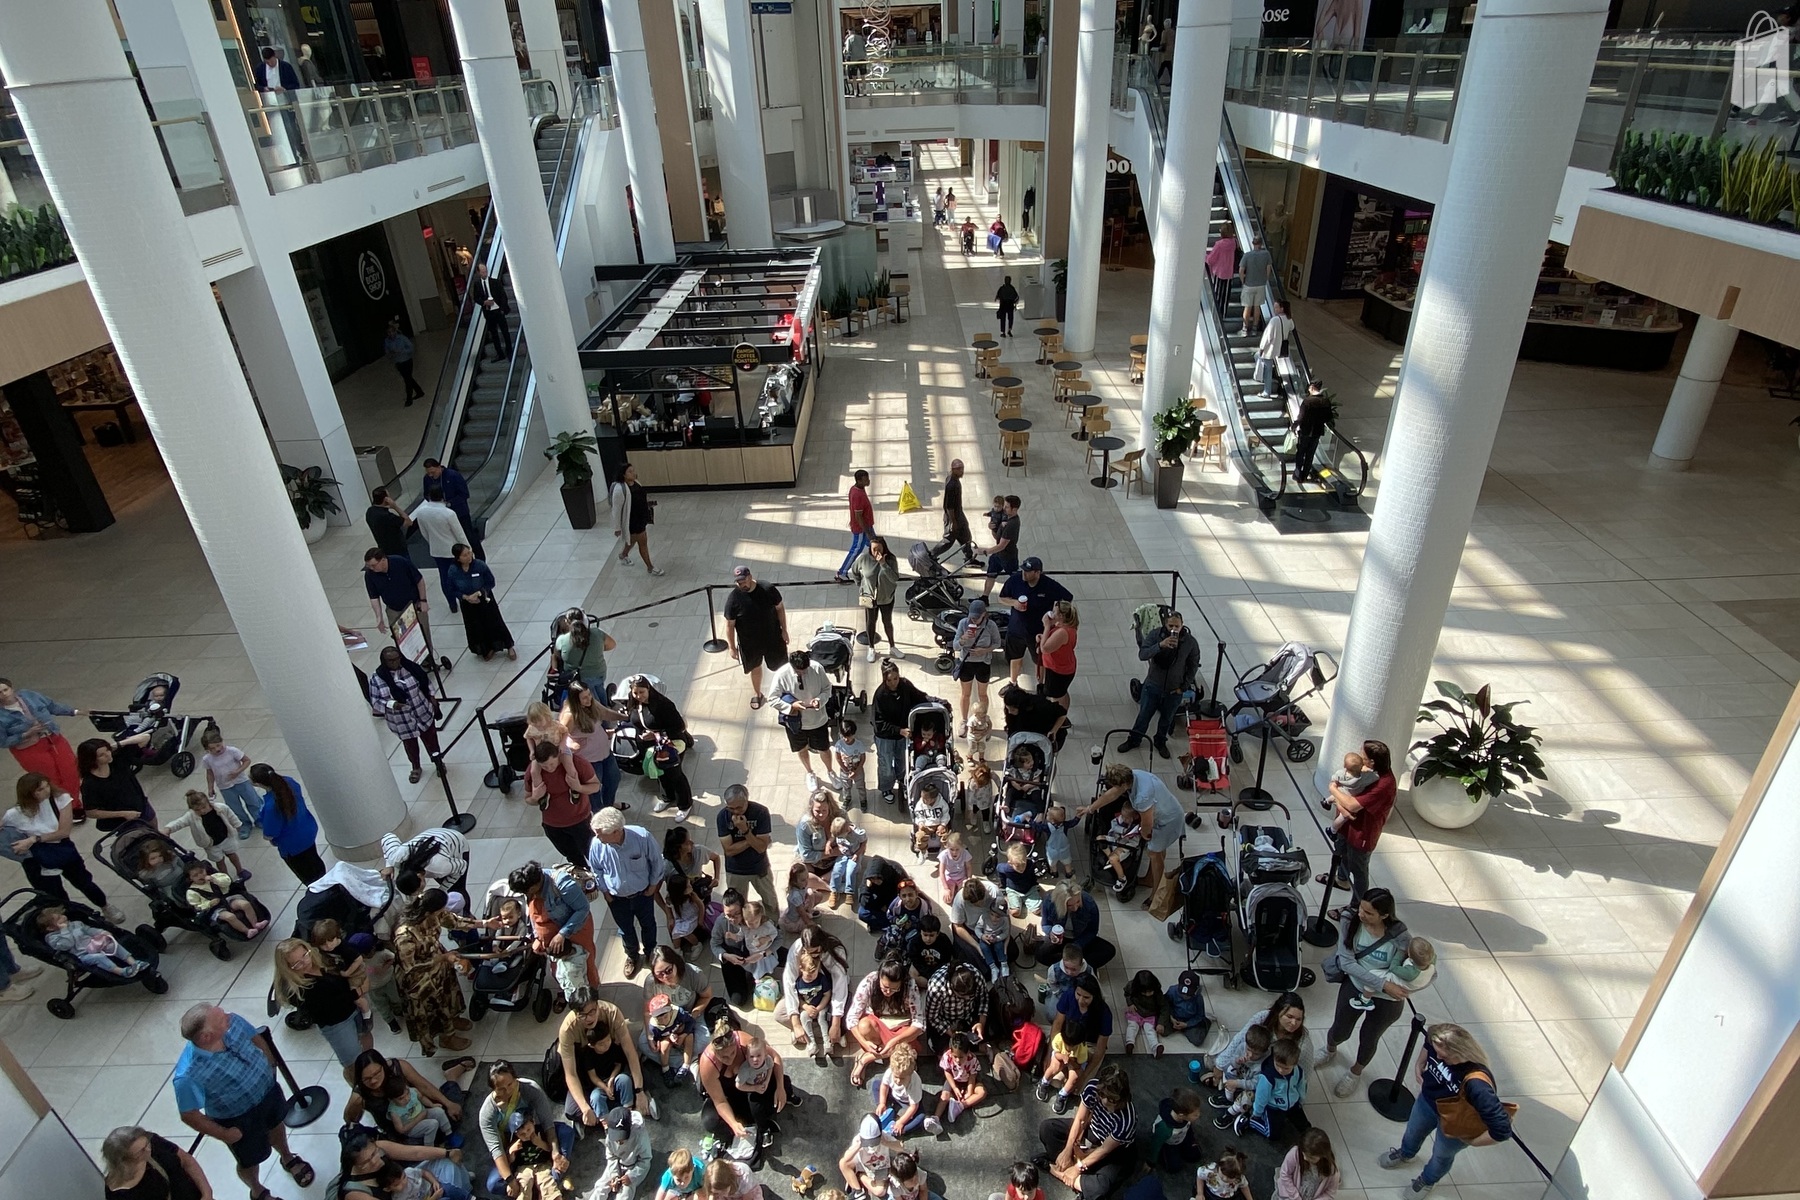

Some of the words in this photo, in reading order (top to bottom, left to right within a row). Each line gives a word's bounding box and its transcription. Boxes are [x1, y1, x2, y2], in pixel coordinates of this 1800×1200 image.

[1262, 8, 1290, 23] ose
[365, 265, 375, 275] THE
[365, 271, 380, 285] BODY
[368, 280, 382, 293] SHOP
